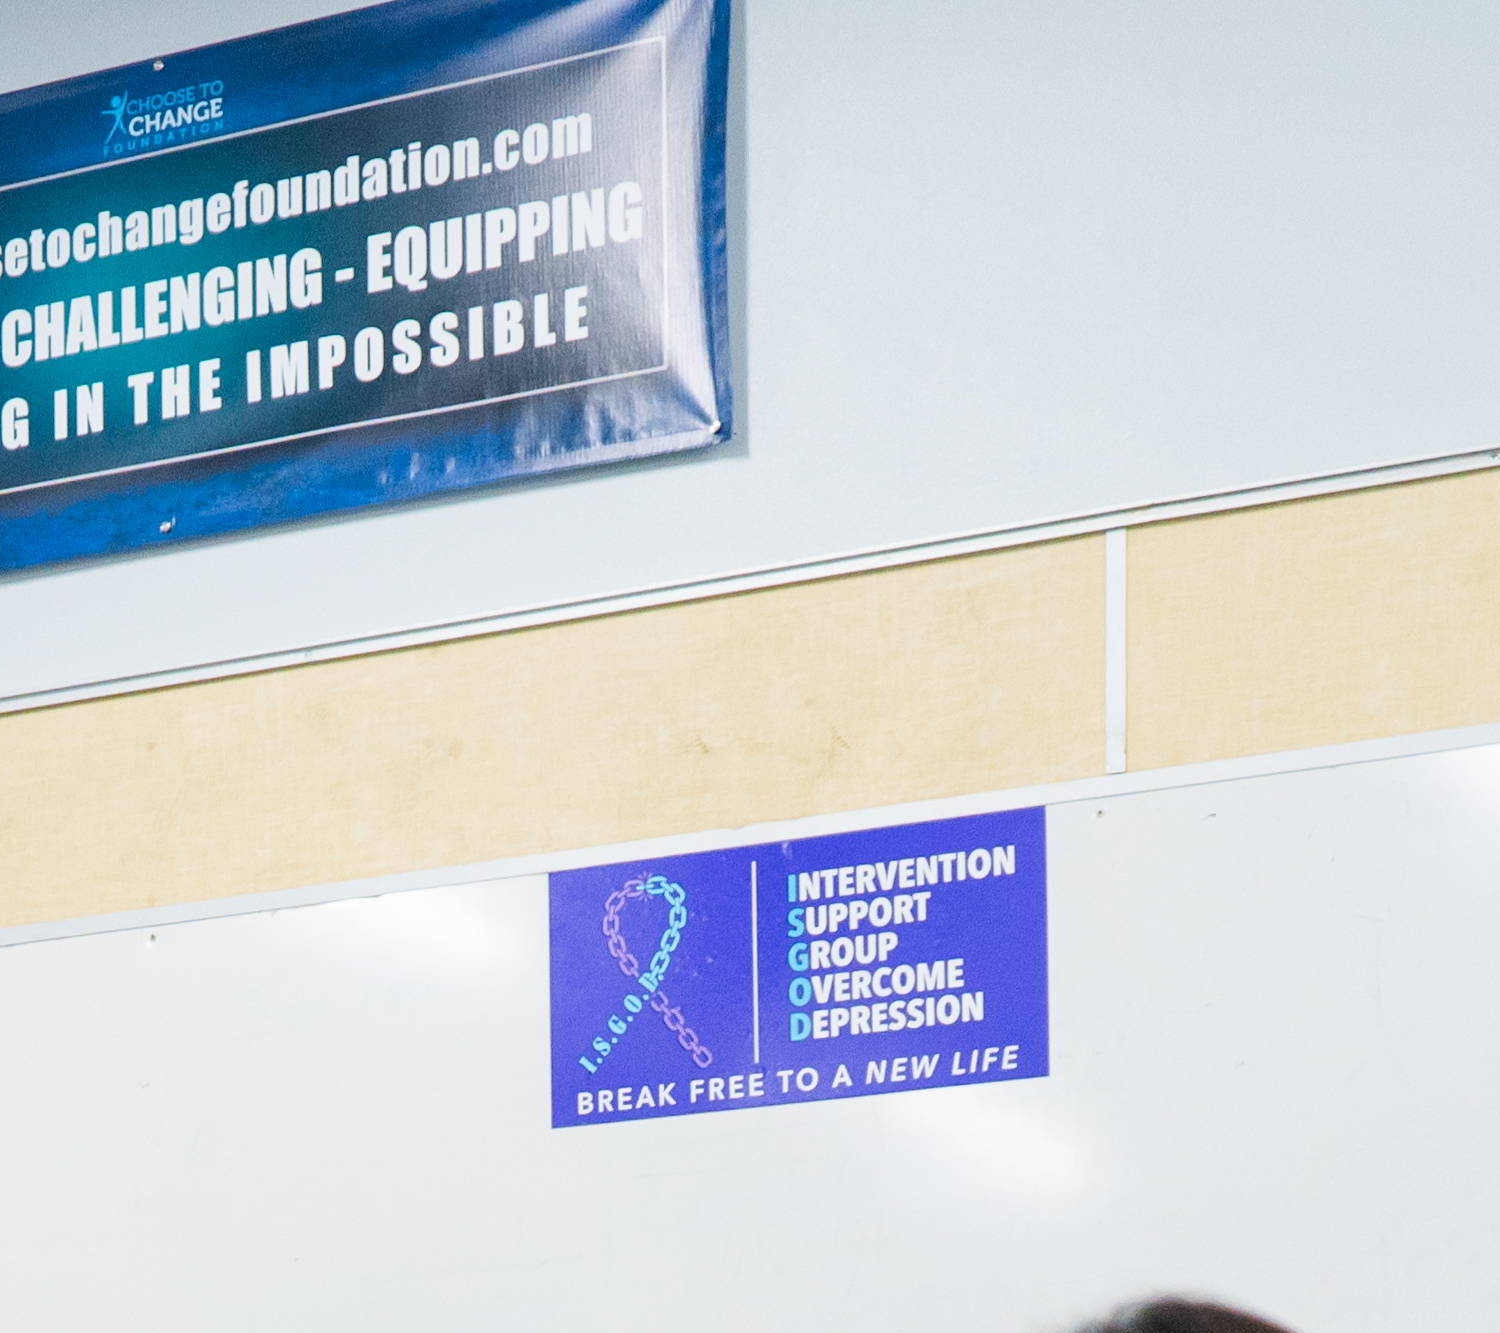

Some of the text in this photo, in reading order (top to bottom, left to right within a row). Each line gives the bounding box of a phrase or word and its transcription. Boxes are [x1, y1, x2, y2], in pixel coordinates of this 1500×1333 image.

[126, 80, 224, 115] CHOOSE TO
[128, 97, 223, 137] CHANGE
[103, 119, 224, 157] FOUNDATION
[2, 248, 322, 367] CHALLENGING
[367, 180, 643, 293] EQUIPPING
[54, 382, 104, 440] IN
[128, 358, 222, 425] THE
[246, 281, 590, 403] IMPOSSIBLE
[788, 844, 1016, 903] INTERVENTION
[787, 891, 932, 938] SUPPORT
[788, 931, 899, 972] GROUP
[789, 958, 966, 1007] OVERCOME
[790, 991, 985, 1042] DEPRESSION
[577, 1044, 1020, 1116] BREAK FREE TO A NEW LIFE
